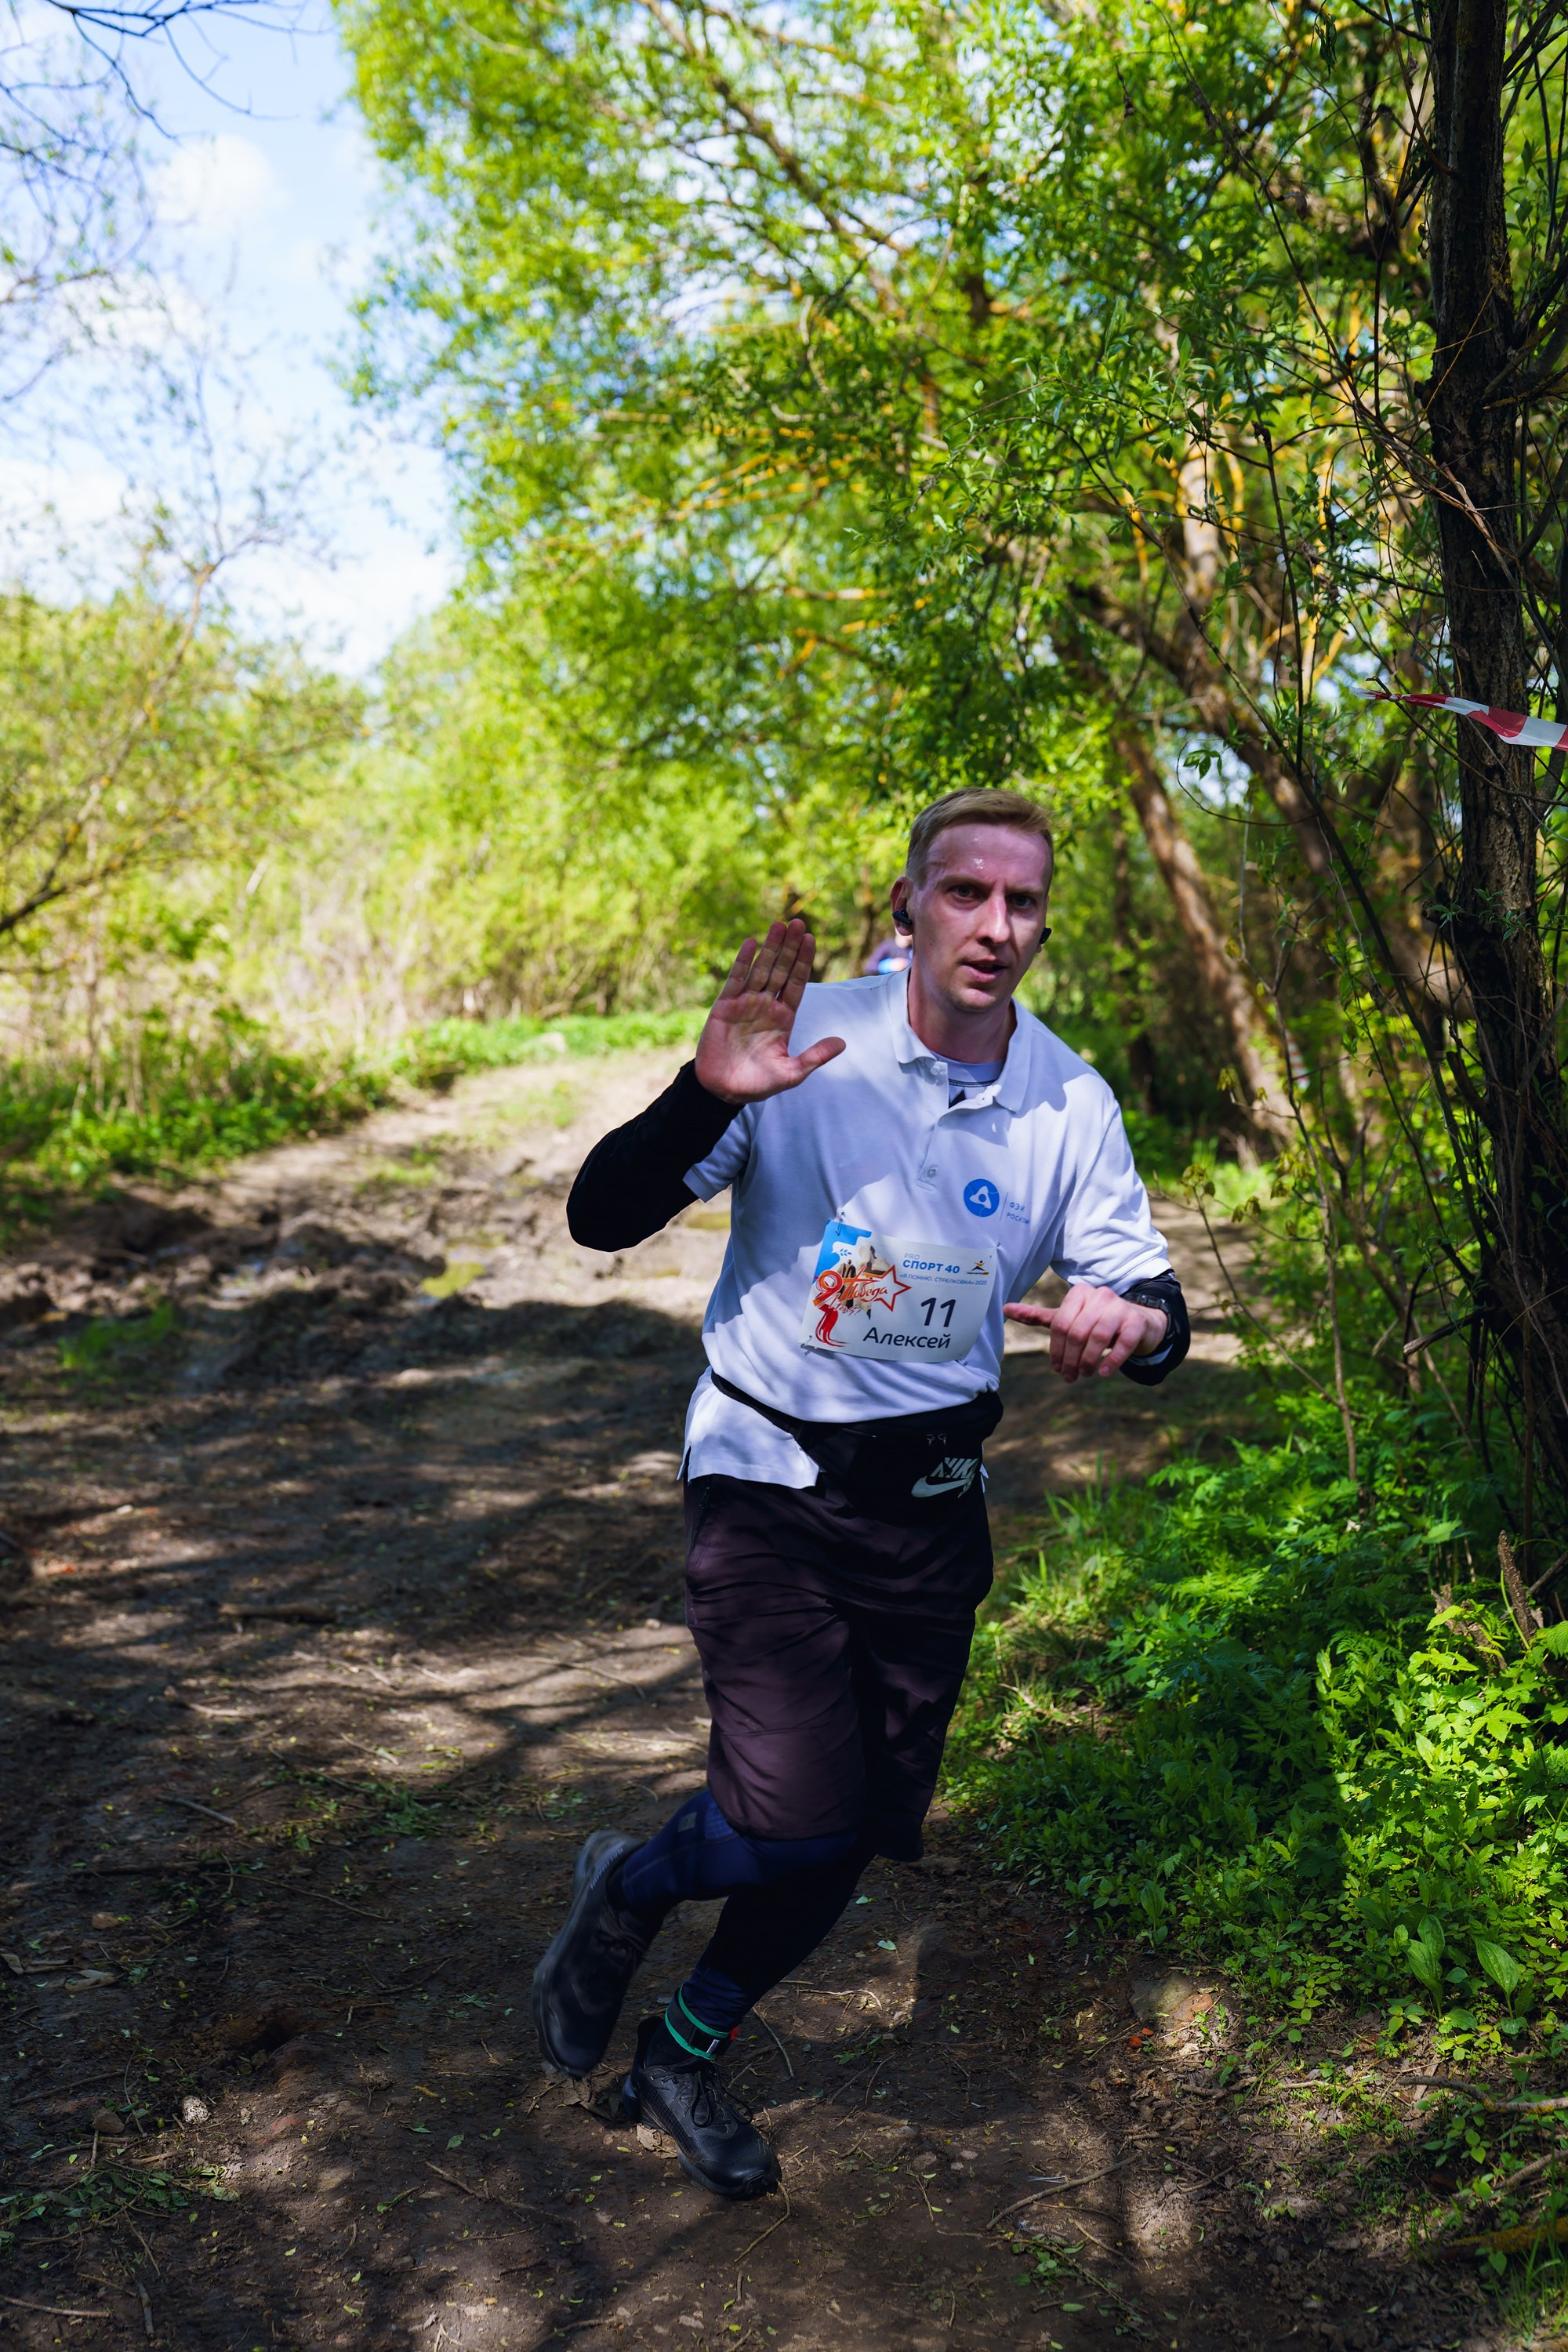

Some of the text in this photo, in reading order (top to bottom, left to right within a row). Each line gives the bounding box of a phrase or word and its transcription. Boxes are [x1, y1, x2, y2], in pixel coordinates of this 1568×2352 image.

[902, 1260, 943, 1272] СПОРТ
[945, 1265, 960, 1274] 40
[920, 1297, 956, 1327] 11
[862, 1327, 952, 1348] Алексей
